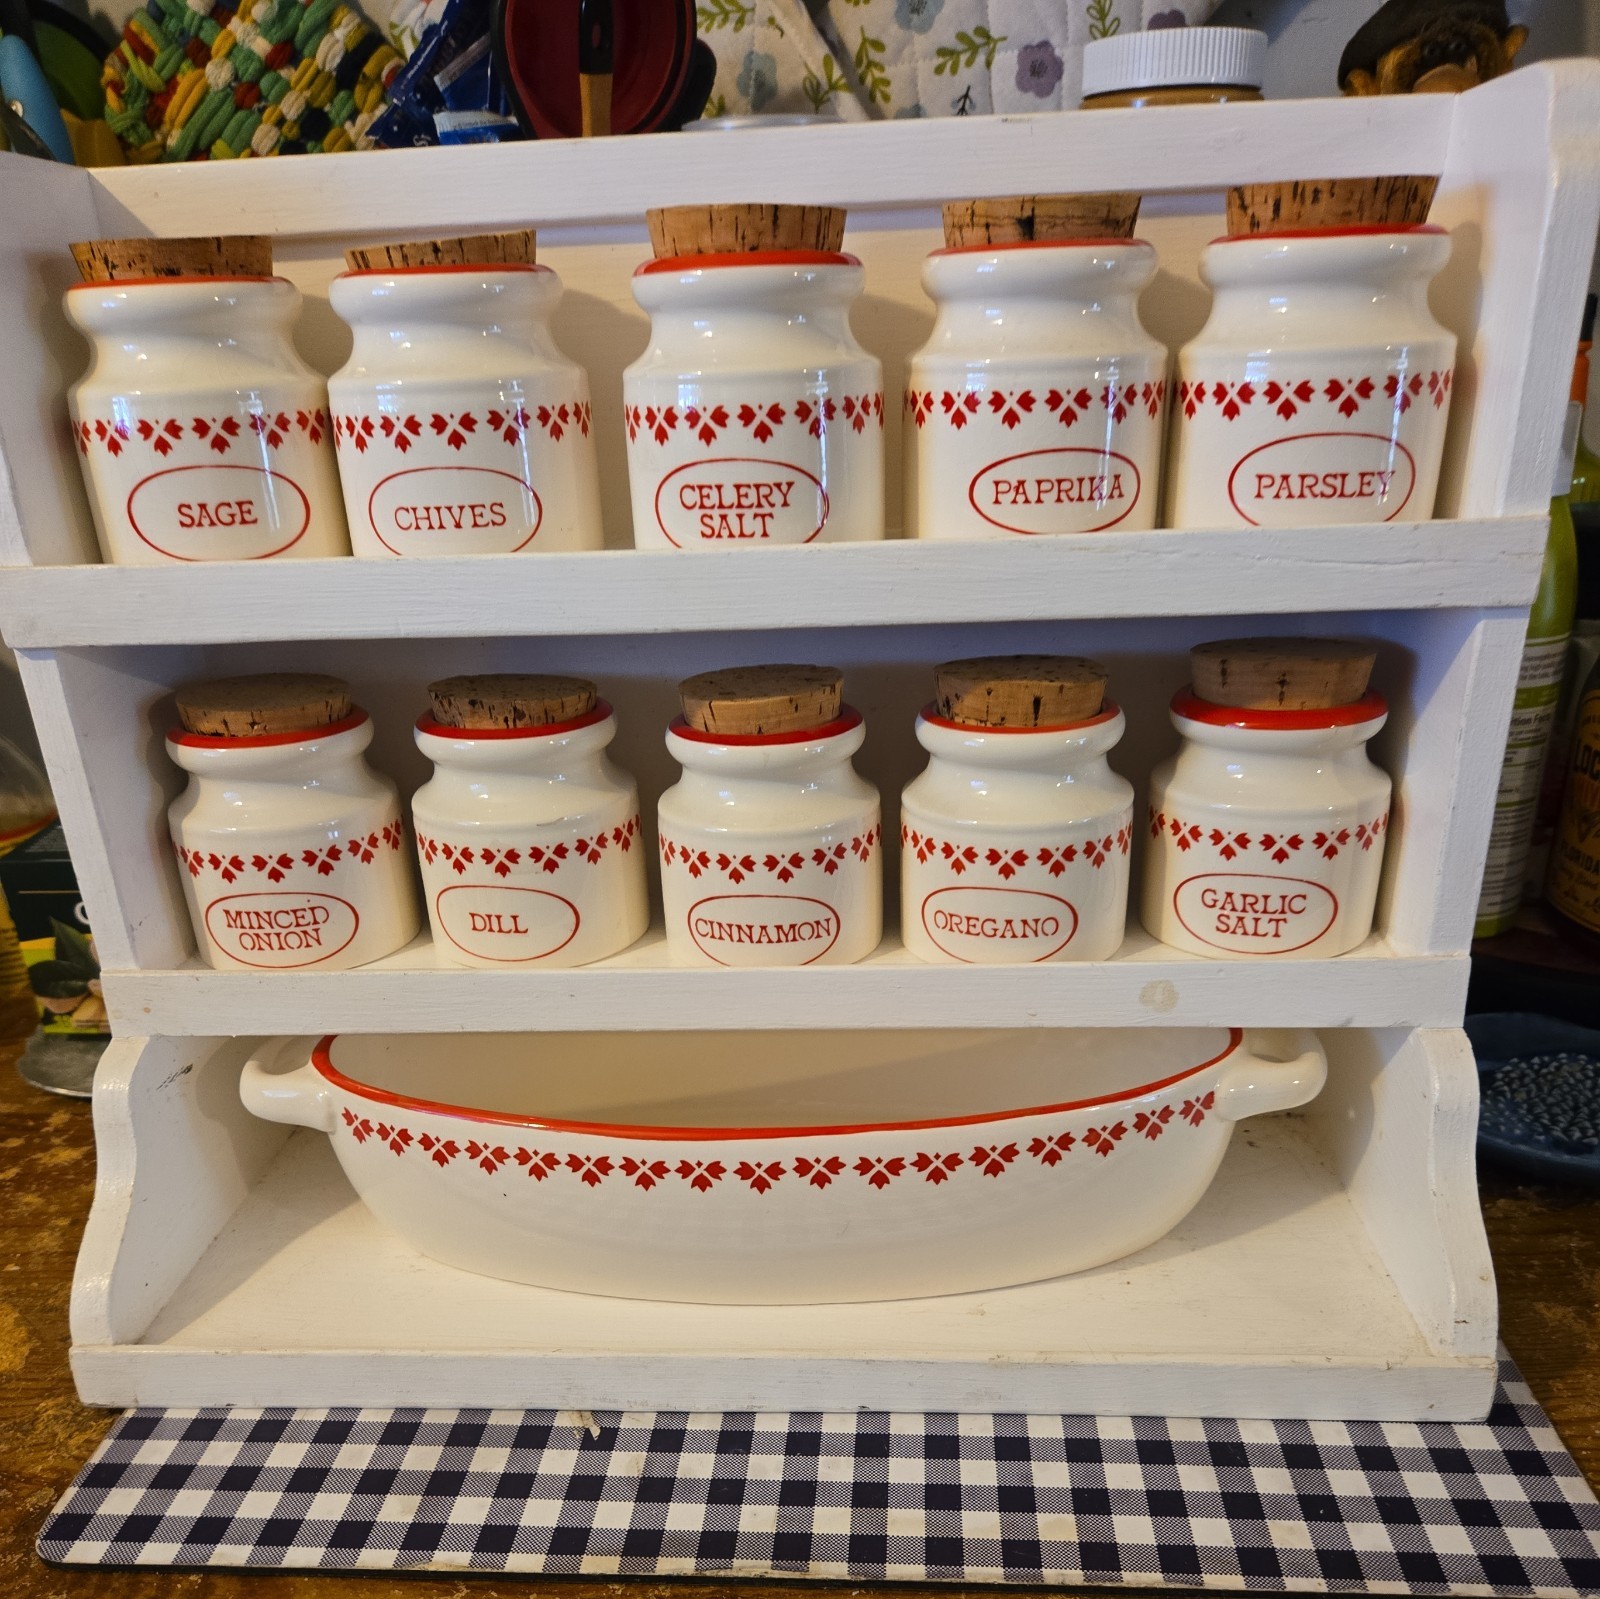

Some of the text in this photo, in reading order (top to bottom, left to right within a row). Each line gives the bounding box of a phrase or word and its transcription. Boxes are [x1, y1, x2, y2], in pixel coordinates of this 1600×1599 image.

[679, 481, 795, 510] CELERY
[991, 474, 1126, 505] PAPRIKA
[1254, 470, 1396, 499] PARSLEY
[177, 499, 258, 529] SAGE
[394, 502, 507, 531] CHIVES
[700, 512, 774, 539] SALT
[1201, 888, 1308, 915] GARLIC
[222, 905, 330, 930] MINCED
[468, 911, 529, 935] DILL
[694, 917, 834, 944] CINNAMON
[933, 909, 1060, 939] OREGANO
[1215, 913, 1288, 938] SALT
[239, 927, 322, 951] ONION
